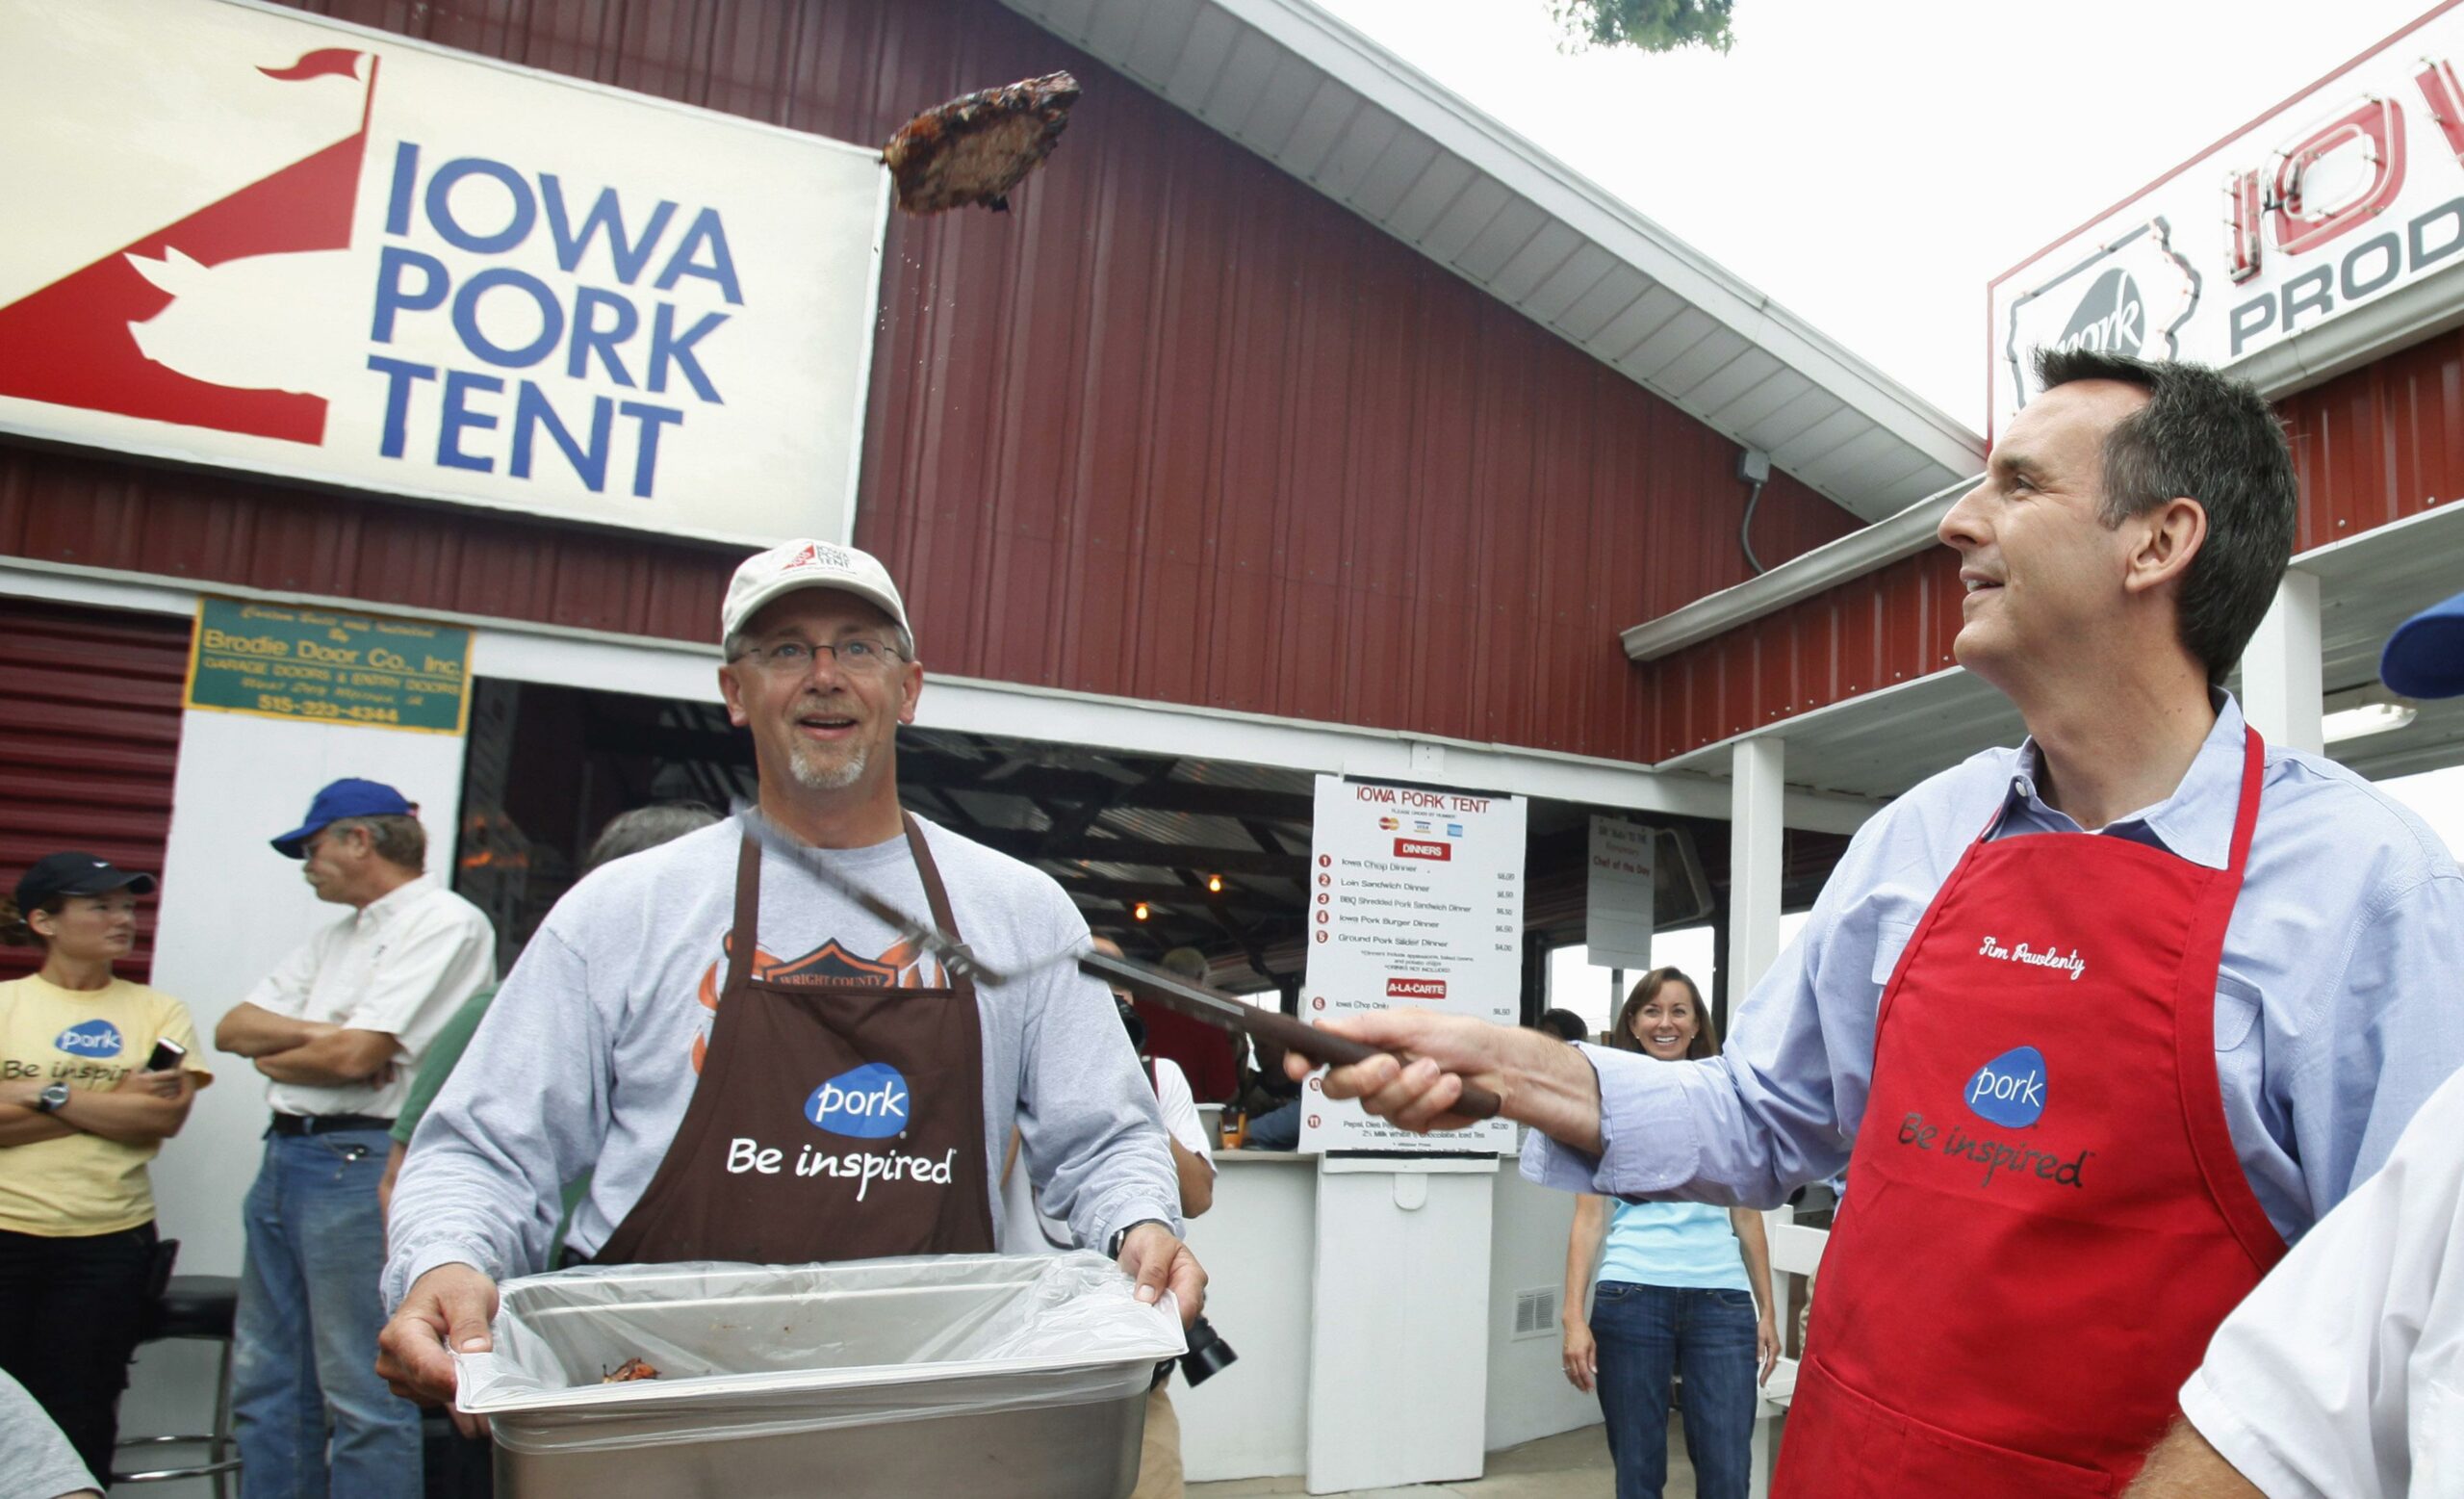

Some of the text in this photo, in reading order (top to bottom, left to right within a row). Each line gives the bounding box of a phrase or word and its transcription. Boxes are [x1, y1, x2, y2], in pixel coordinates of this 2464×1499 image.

[385, 141, 744, 306] IOWA
[2229, 195, 2464, 358] PROD
[371, 246, 732, 405] PORK
[367, 353, 684, 499] TENT
[203, 629, 289, 656] Brodie
[296, 639, 361, 664] Door
[1356, 786, 1490, 814] IOWA PORK TENT
[1402, 843, 1442, 856] DINNERS
[1342, 859, 1362, 867] Iowa
[1364, 860, 1388, 872] Chop
[1390, 863, 1417, 871] Dinner
[1341, 878, 1359, 887] Loin
[1361, 880, 1401, 890] Sandwich
[1404, 883, 1429, 892] Dinner
[1340, 895, 1357, 906] BBQ
[1358, 896, 1393, 907] Shredded
[1414, 901, 1447, 911] Sandwich
[1449, 904, 1472, 913] Dinner
[1361, 916, 1380, 924] Pork
[1383, 917, 1411, 927] Burger
[1413, 919, 1439, 928] Dinner
[1338, 934, 1371, 943] Ground
[1373, 936, 1393, 944] Pork
[1422, 939, 1448, 948] Dinner
[1979, 936, 2086, 980] Tim Pawlenty
[780, 974, 882, 986] WRIGHT COUNTY
[1388, 983, 1445, 995] A-LA-CARTE
[1353, 1000, 1371, 1010] Chop
[62, 1029, 121, 1050] pork
[3, 1059, 132, 1092] Be inspir
[1970, 1067, 2043, 1107] pork
[815, 1080, 907, 1123] pork
[1898, 1112, 2088, 1189] Be inspired
[727, 1138, 954, 1202] Be inspired
